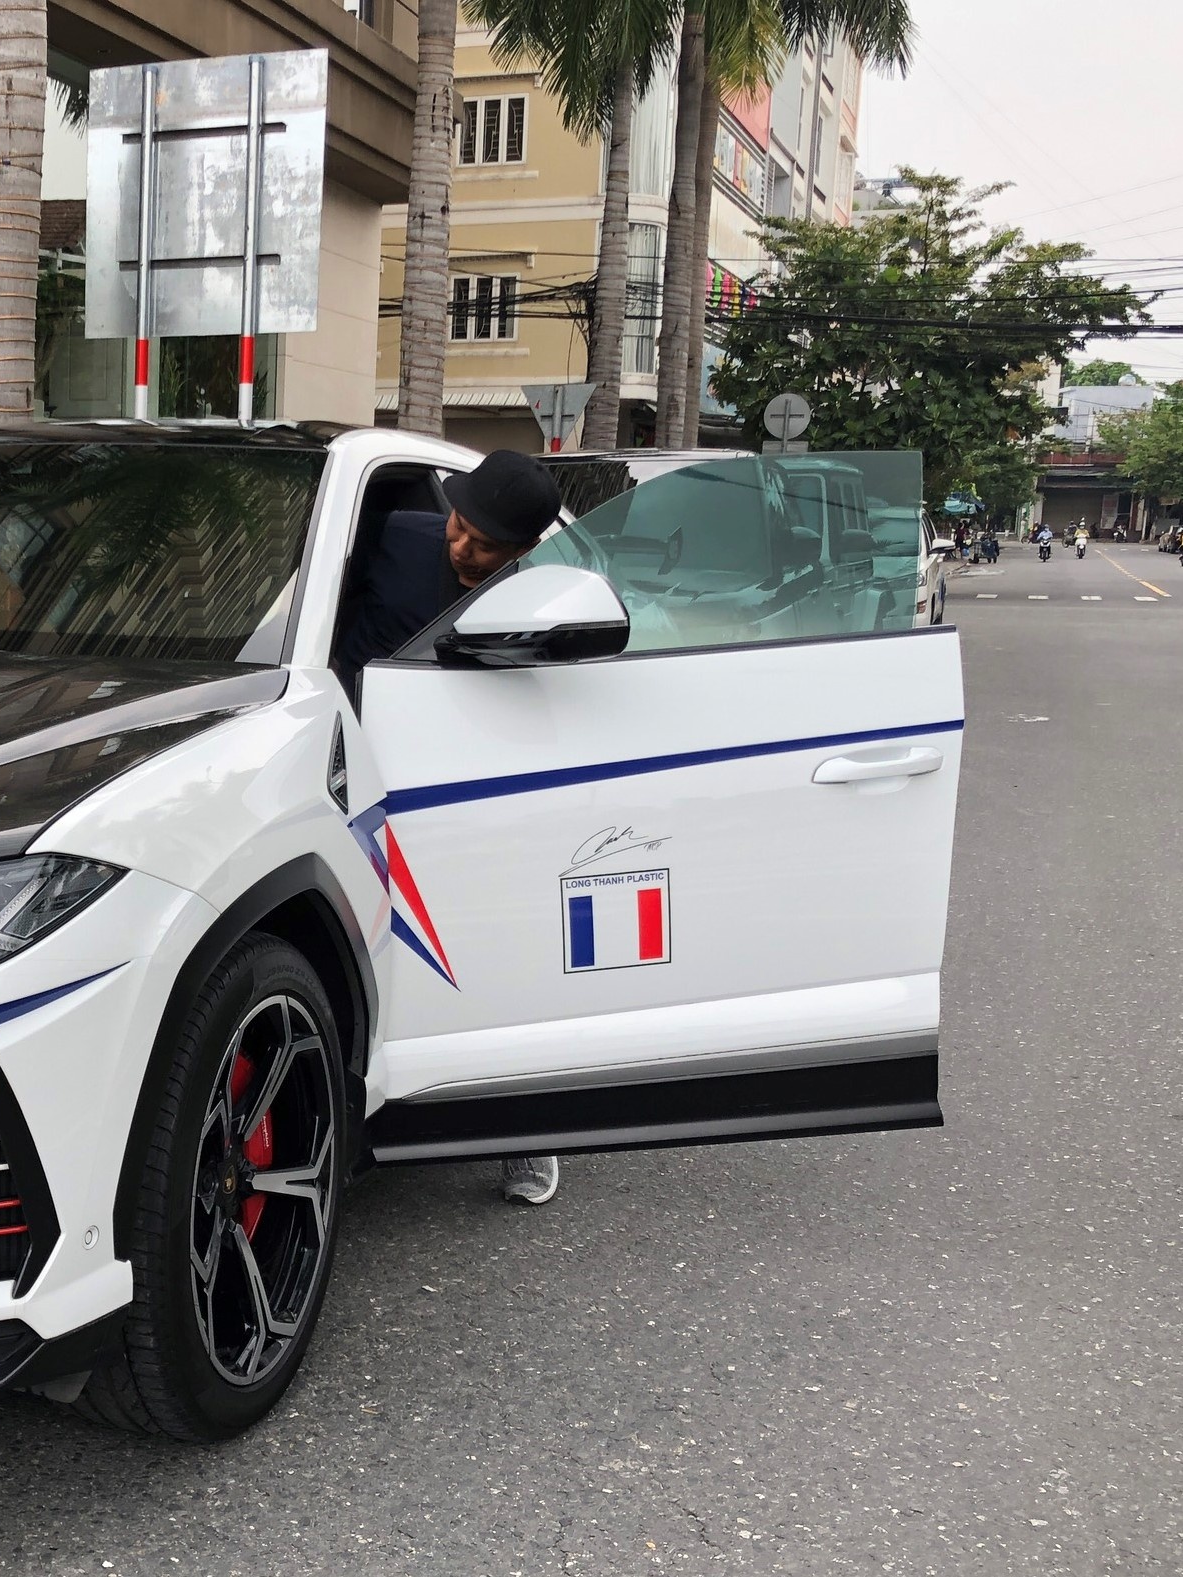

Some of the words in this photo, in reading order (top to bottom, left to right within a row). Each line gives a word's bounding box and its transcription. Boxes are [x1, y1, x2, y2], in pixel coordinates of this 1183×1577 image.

[565, 879, 591, 889] LONG
[593, 876, 624, 887] THANH
[627, 872, 664, 884] PLASTIC
